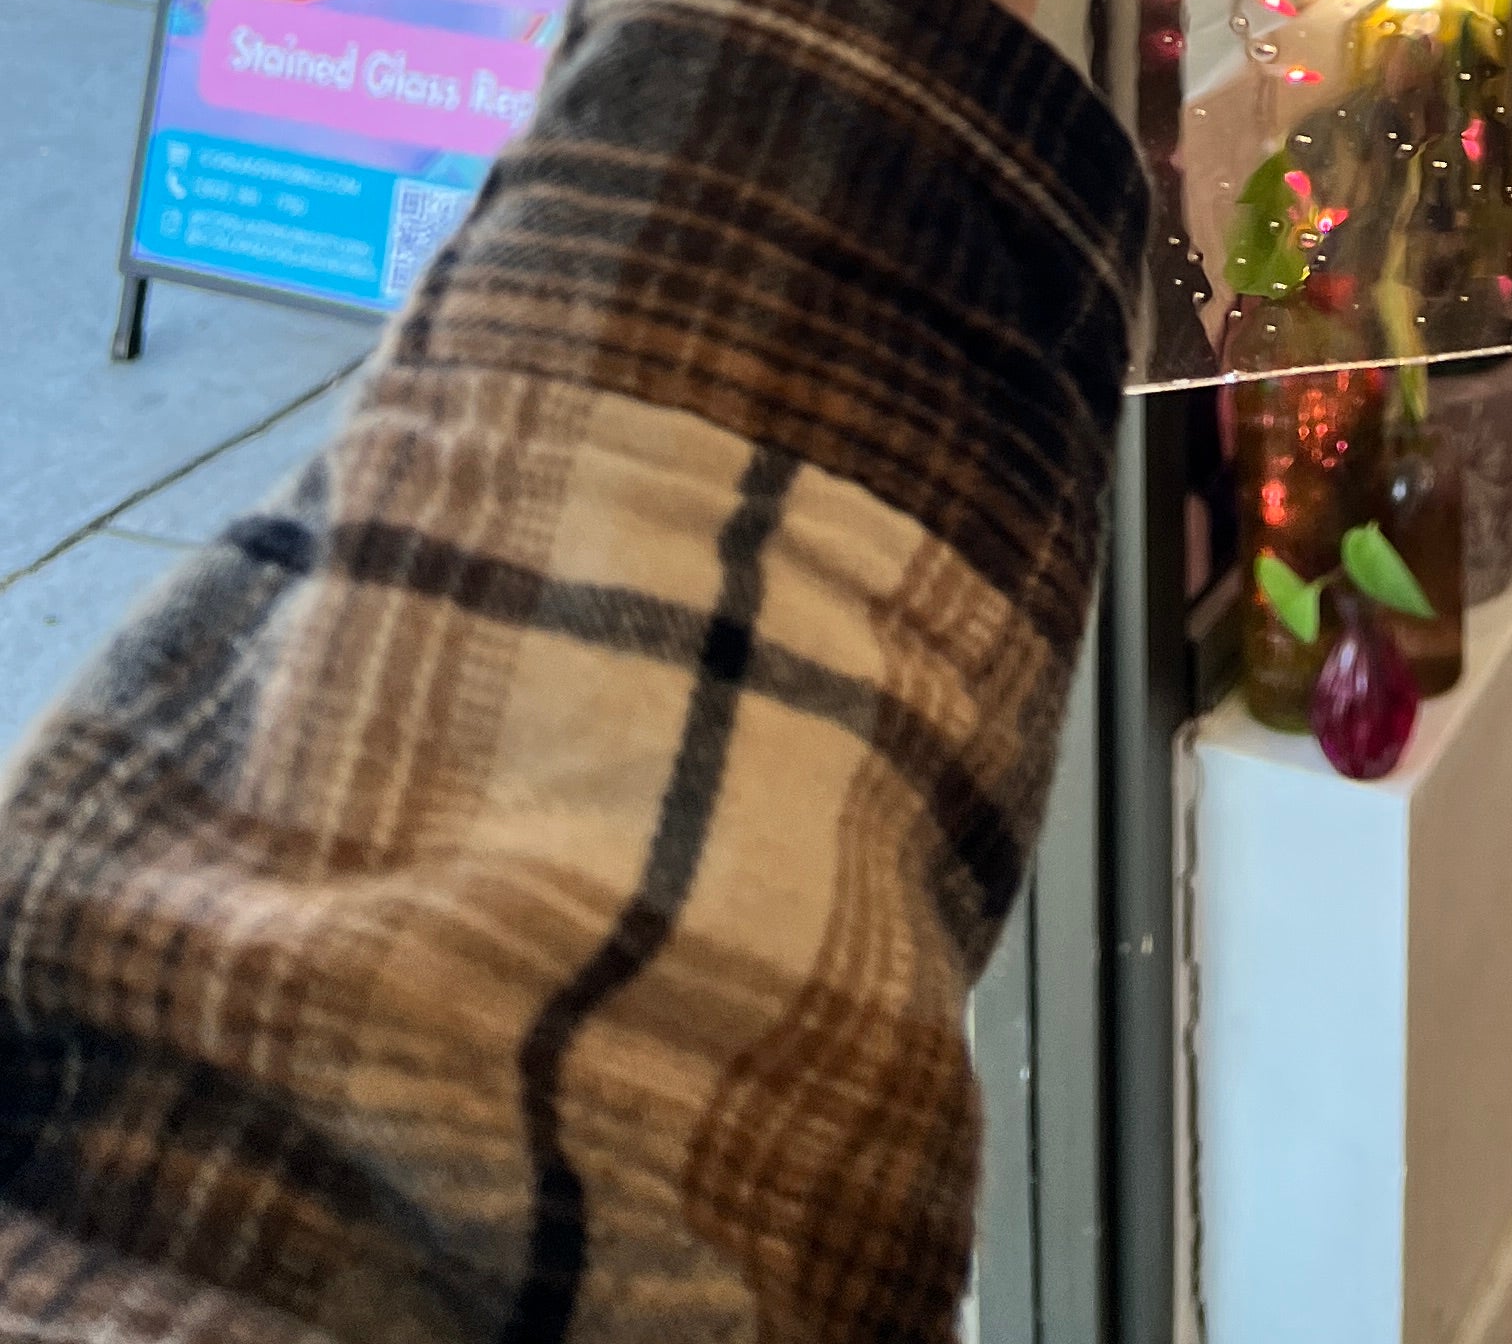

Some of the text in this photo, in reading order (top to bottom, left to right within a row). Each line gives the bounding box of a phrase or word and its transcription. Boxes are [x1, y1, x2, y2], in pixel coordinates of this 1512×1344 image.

[230, 24, 537, 130] Stained Glass Rep
